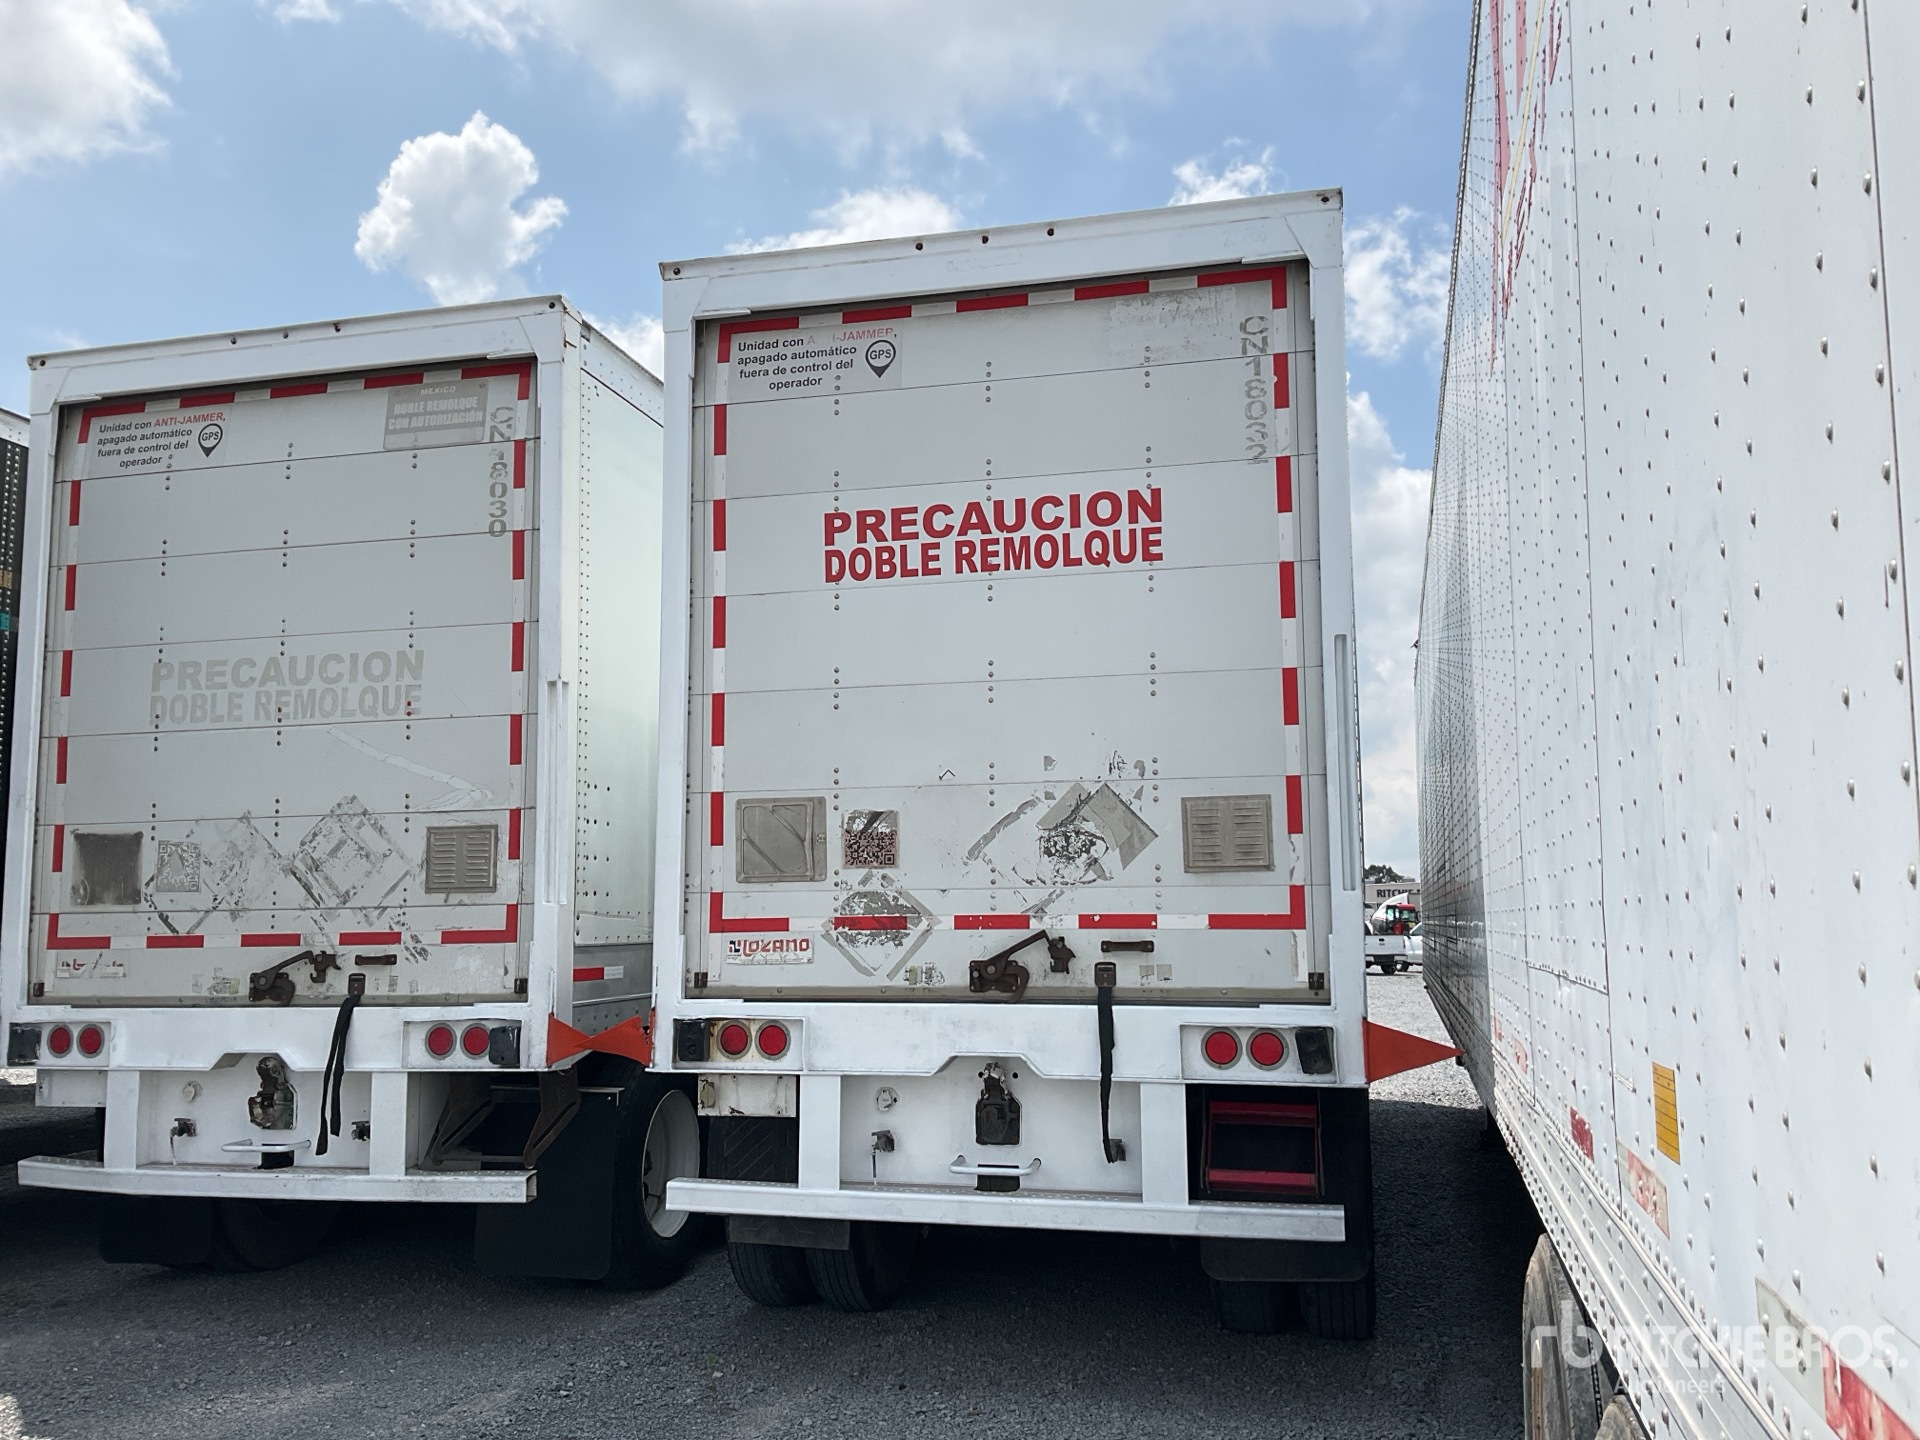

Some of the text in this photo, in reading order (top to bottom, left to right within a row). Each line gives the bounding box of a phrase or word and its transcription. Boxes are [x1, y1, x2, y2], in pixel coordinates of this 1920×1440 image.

[738, 327, 897, 352] Unidad con AI-JAMMER,
[737, 346, 857, 366] apagado automático
[869, 349, 892, 360] GPS
[739, 359, 853, 378] fuera de control del
[769, 377, 823, 391] operador
[393, 396, 478, 415] DOBLE REMOLQUE
[99, 412, 226, 433] Unidad con ANTI-JAMMER,
[388, 416, 409, 430] CON
[97, 428, 192, 446] apagado automático
[201, 431, 220, 442] GPS
[97, 439, 189, 457] fuera de control del
[119, 456, 163, 469] operador
[823, 487, 1163, 546] PRECAUCION
[824, 526, 1164, 583] DOBLE REMOLQUE
[151, 650, 424, 692] PRECAUCION
[150, 684, 422, 726] DOBLE REMOLQUE
